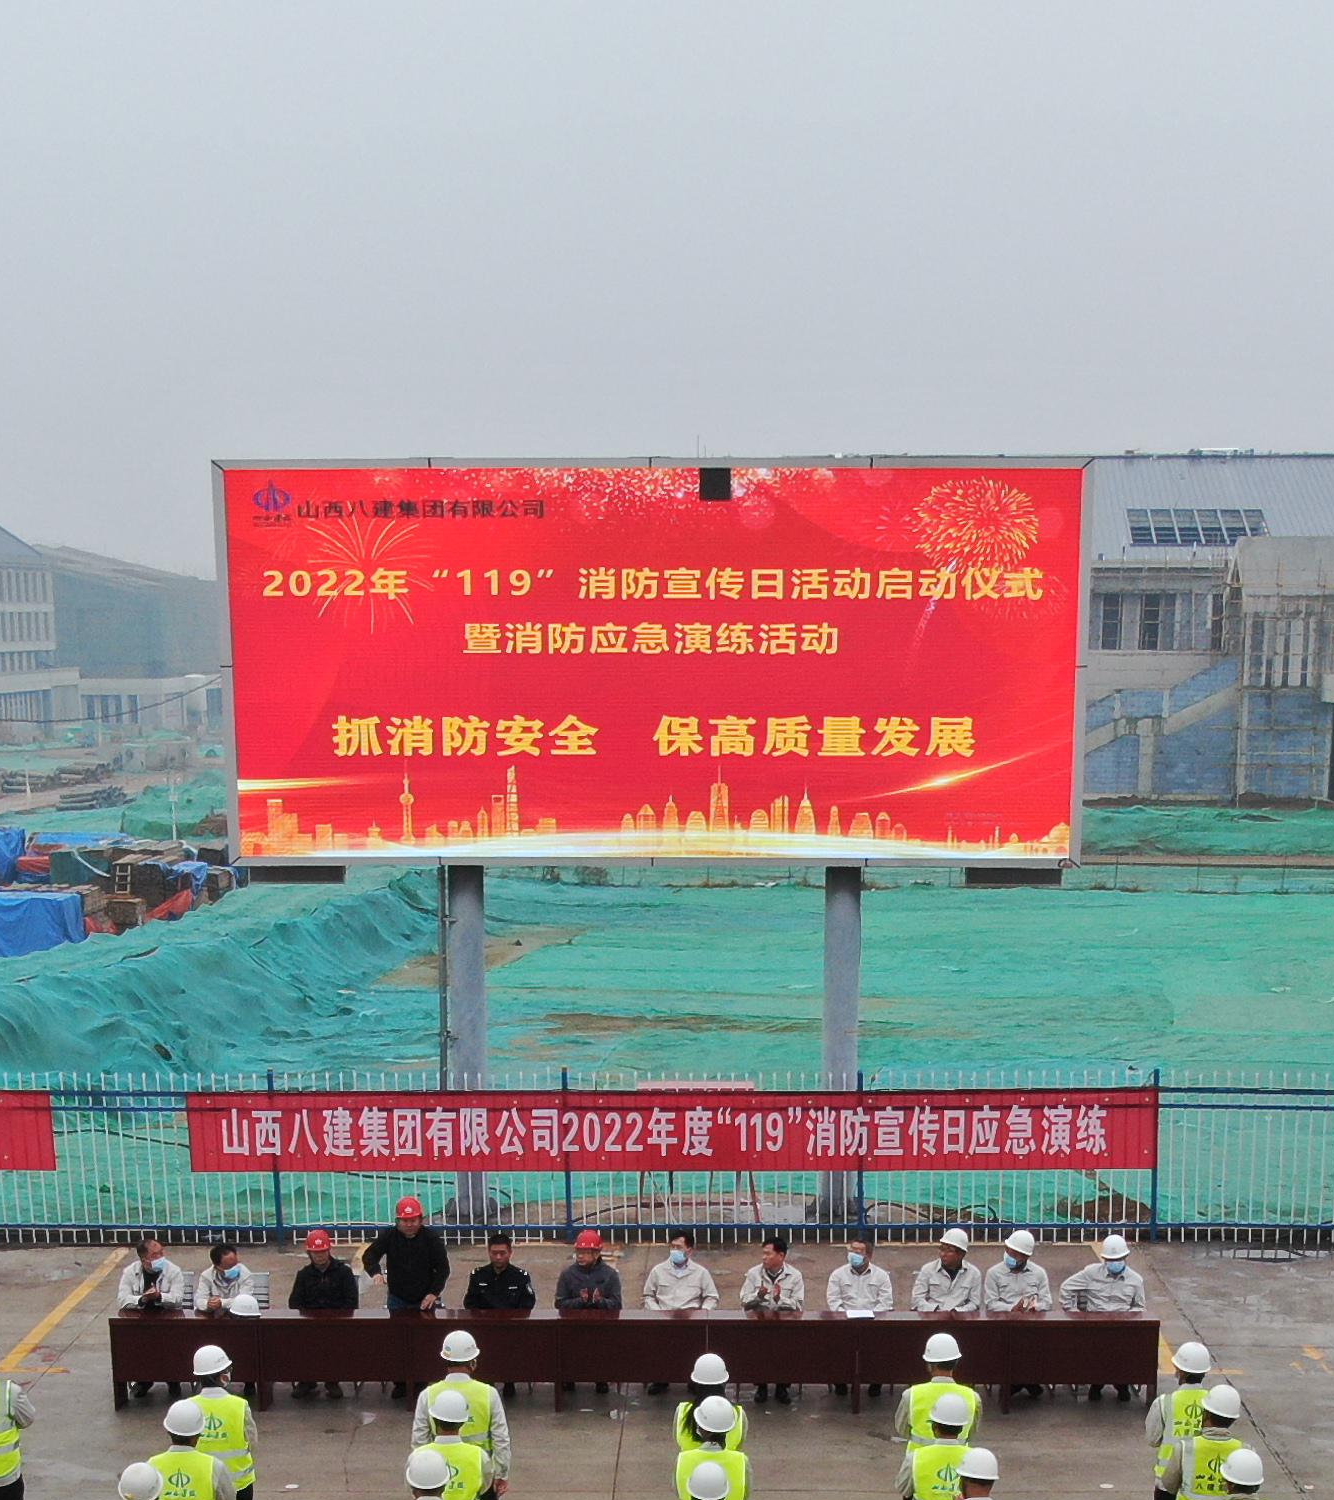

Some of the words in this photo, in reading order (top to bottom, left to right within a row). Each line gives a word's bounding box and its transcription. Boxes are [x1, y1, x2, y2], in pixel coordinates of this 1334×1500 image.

[296, 499, 545, 519] 山西八建集团有限公司
[463, 622, 839, 657] 暨消防应急演练活动
[332, 713, 600, 759] 抓消防安全
[652, 714, 977, 759] 保高质量发展
[220, 1104, 1109, 1159] 山西八建集团有限公司2022年度“119”消防宣传日应急演练
